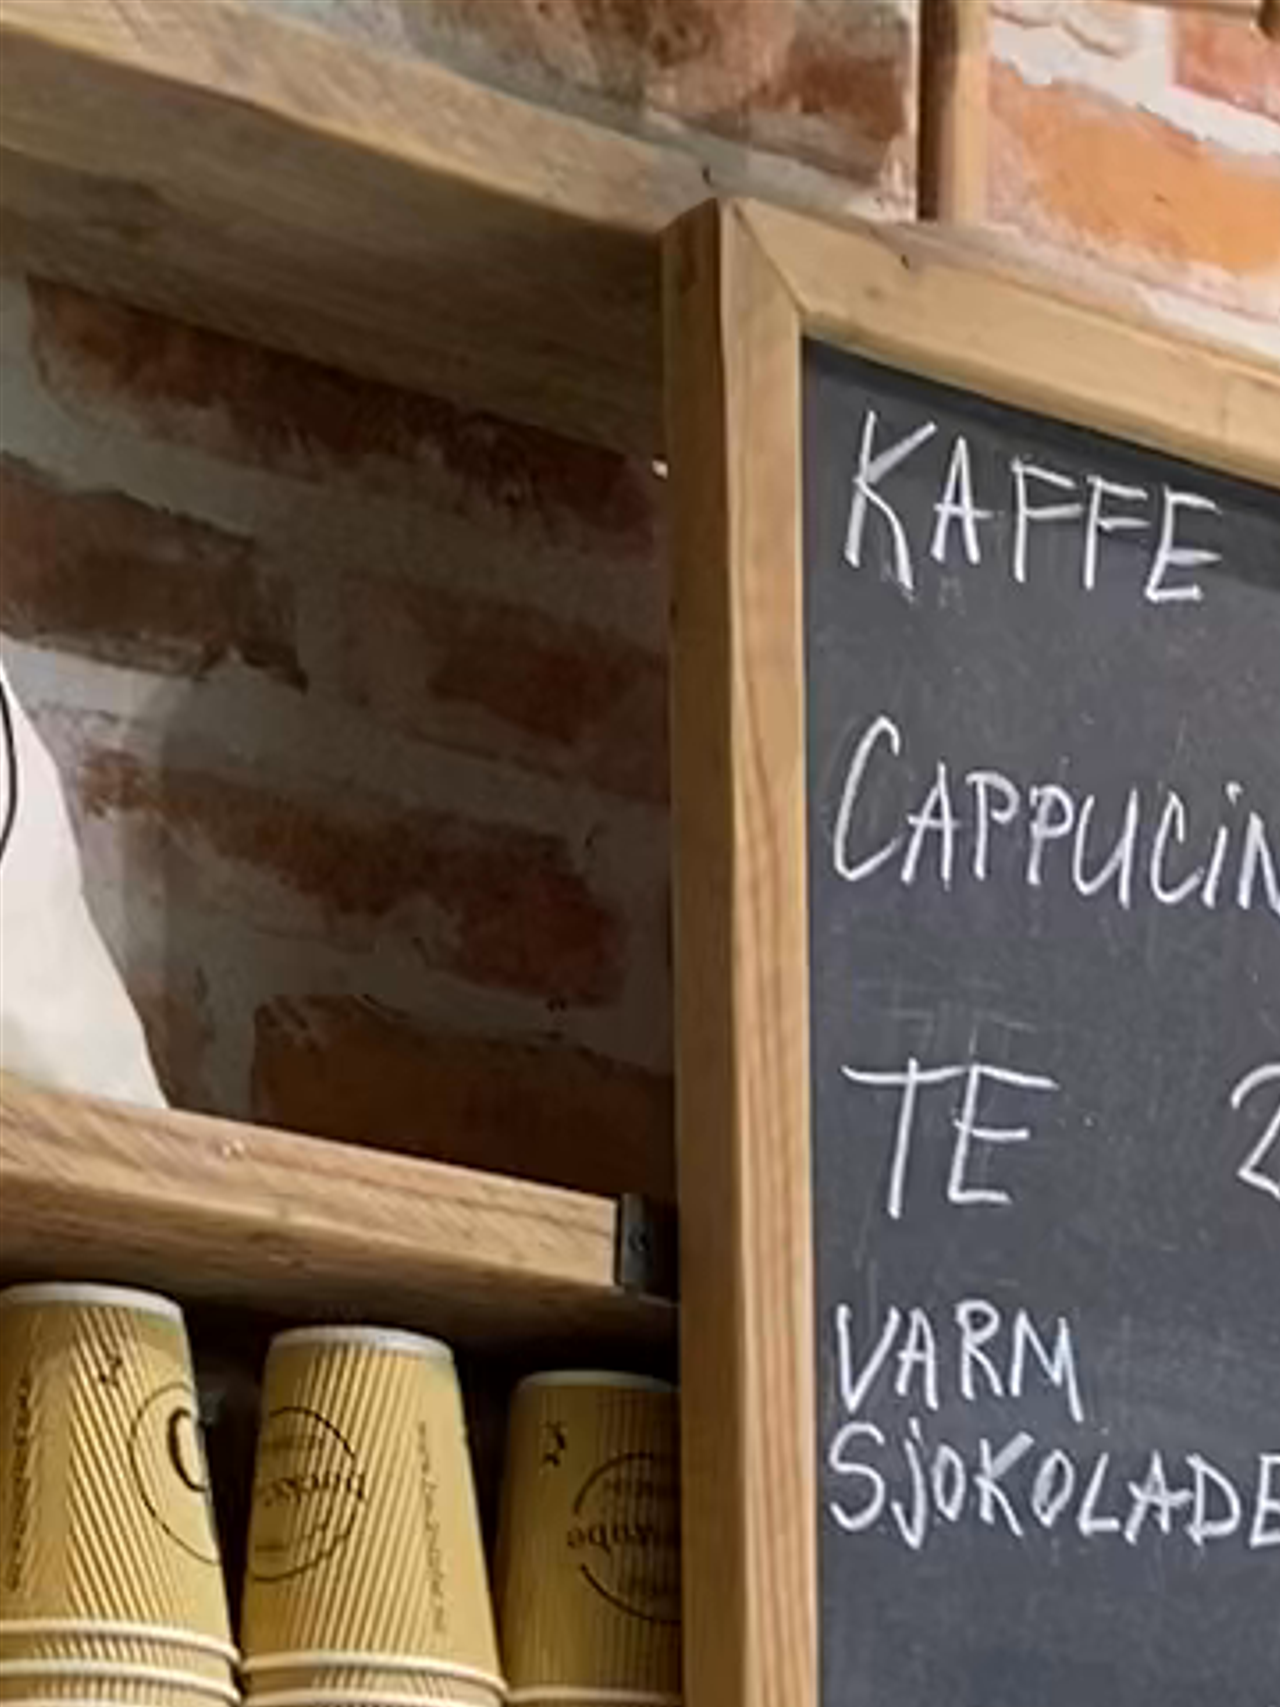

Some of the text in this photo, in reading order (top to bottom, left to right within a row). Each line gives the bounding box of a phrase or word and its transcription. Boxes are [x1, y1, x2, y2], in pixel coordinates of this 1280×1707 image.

[843, 408, 1221, 602] KAFFE
[841, 1057, 1057, 1220] TE
[835, 1298, 1084, 1422] VARM
